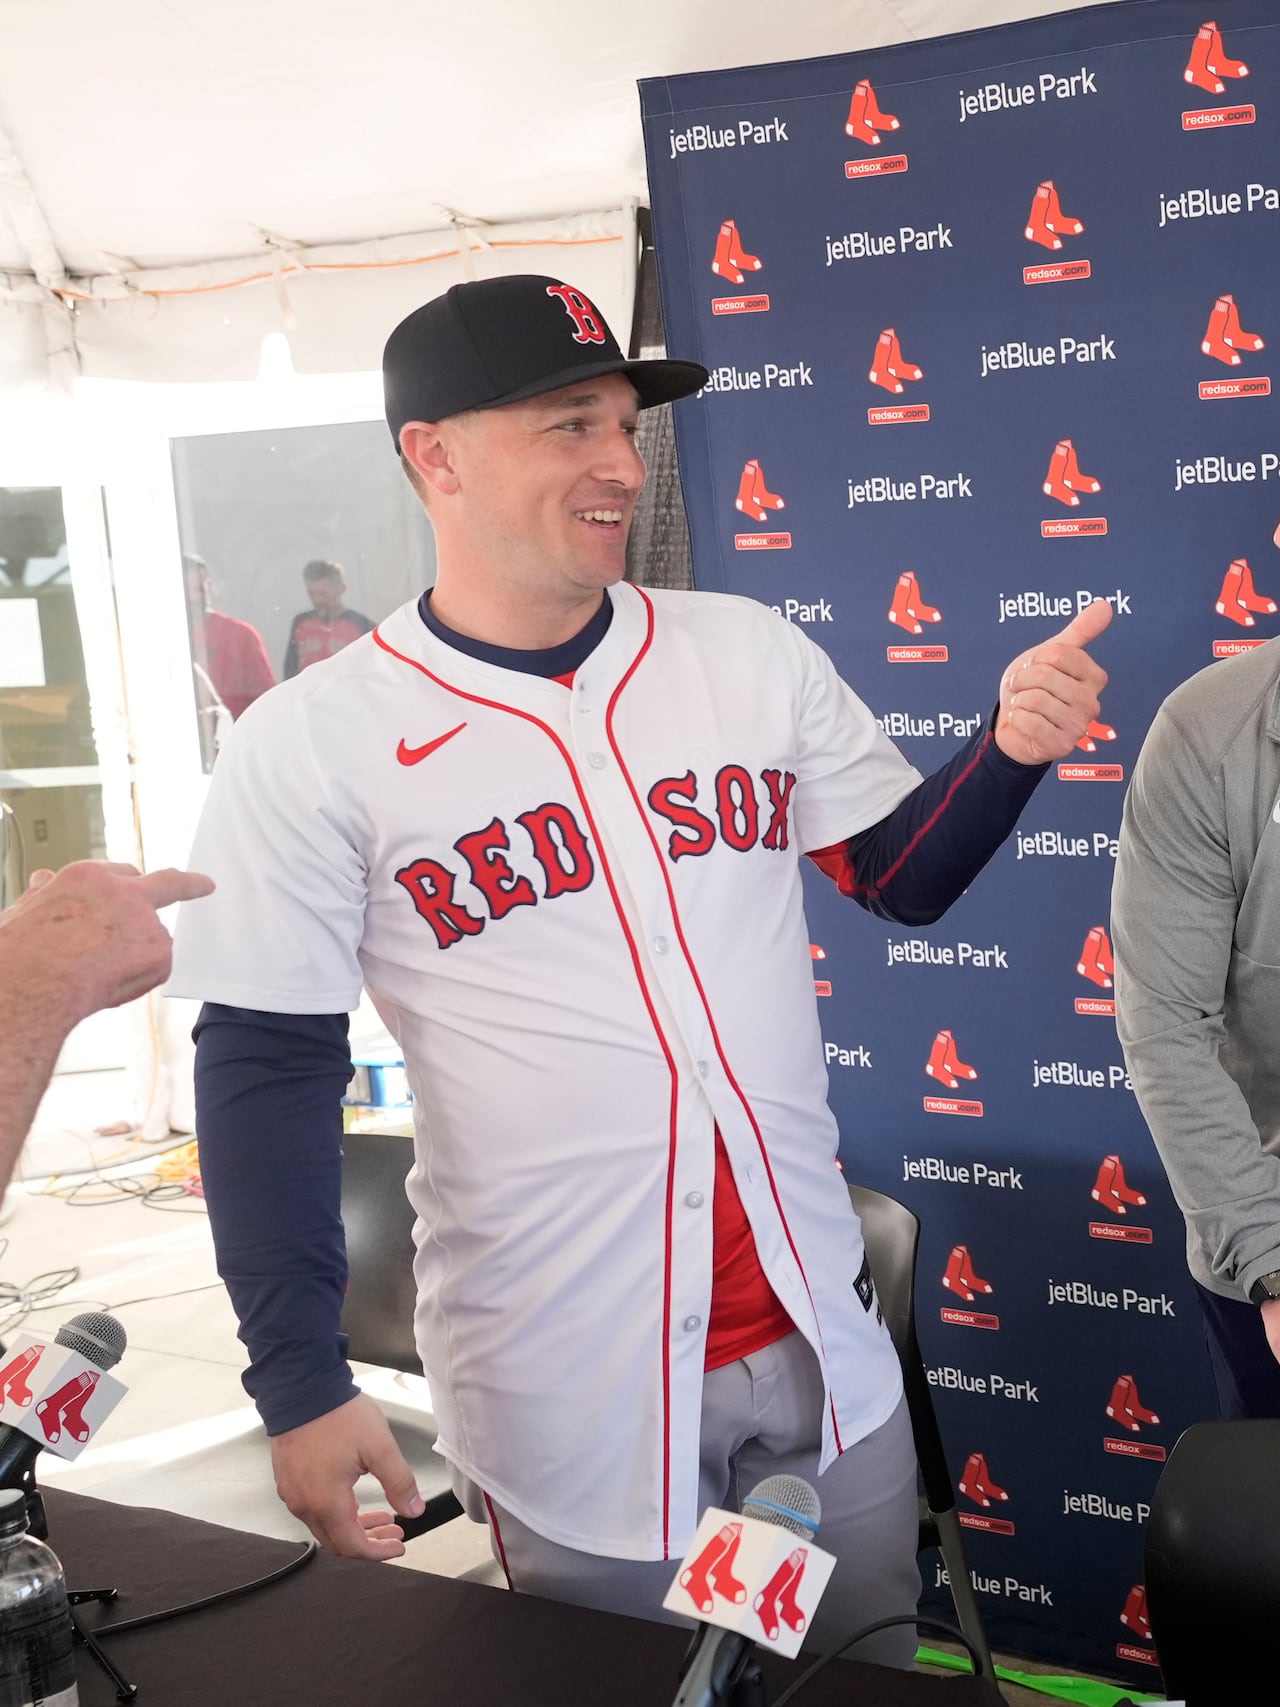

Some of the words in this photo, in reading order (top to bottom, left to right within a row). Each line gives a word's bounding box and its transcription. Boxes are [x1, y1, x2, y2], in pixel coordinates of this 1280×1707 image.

[960, 83, 1035, 122] jetBlue
[1039, 68, 1097, 101] Park
[1185, 109, 1251, 126] redsox.com
[670, 125, 735, 159] jetBlue
[739, 118, 788, 145] Park
[848, 159, 905, 174] redsox.com
[1159, 189, 1241, 227] jetBlue
[826, 232, 895, 266] jetBlue
[900, 223, 953, 252] Park
[1026, 265, 1087, 280] redsox.com
[546, 284, 606, 345] B
[715, 299, 766, 311] redsox.com
[981, 342, 1055, 377] jetBlue
[1060, 335, 1116, 363] Park
[765, 362, 813, 388] Park
[1202, 382, 1267, 395] redsox.com
[871, 409, 927, 421] redsox.com
[1175, 457, 1256, 490] jetBlue
[848, 477, 916, 508] jetBlue
[921, 473, 972, 499] Park
[738, 537, 788, 547] redsox.com
[1044, 522, 1104, 534] redsox.com
[785, 599, 833, 622] Park
[999, 592, 1072, 622] jetBlue
[890, 649, 945, 659] redsox.com
[1216, 643, 1253, 653] redsox
[1060, 767, 1120, 778] redsox.com
[395, 802, 595, 950] RED
[647, 764, 797, 863] SOX
[1017, 831, 1088, 859] jetBlue
[1093, 832, 1120, 858] Pa
[888, 939, 954, 966] jetBlue
[958, 943, 1008, 968] Park
[1078, 1002, 1114, 1012] redsox.
[824, 1042, 872, 1068] Park
[1033, 1060, 1104, 1087] jetBlue
[1109, 1066, 1133, 1090] Pa
[927, 1100, 980, 1112] redsox.com
[903, 1155, 969, 1183] jetBlue
[974, 1164, 1023, 1189] Park
[1048, 1279, 1118, 1308] jetBlue
[1123, 1289, 1175, 1316] Park
[924, 1364, 987, 1393] etBlue
[990, 1375, 1039, 1402] Park
[1064, 1490, 1132, 1521] jetBlue
[935, 1564, 1001, 1595] jelue
[1005, 1577, 1053, 1605] Park
[1119, 1646, 1149, 1660] redsox
